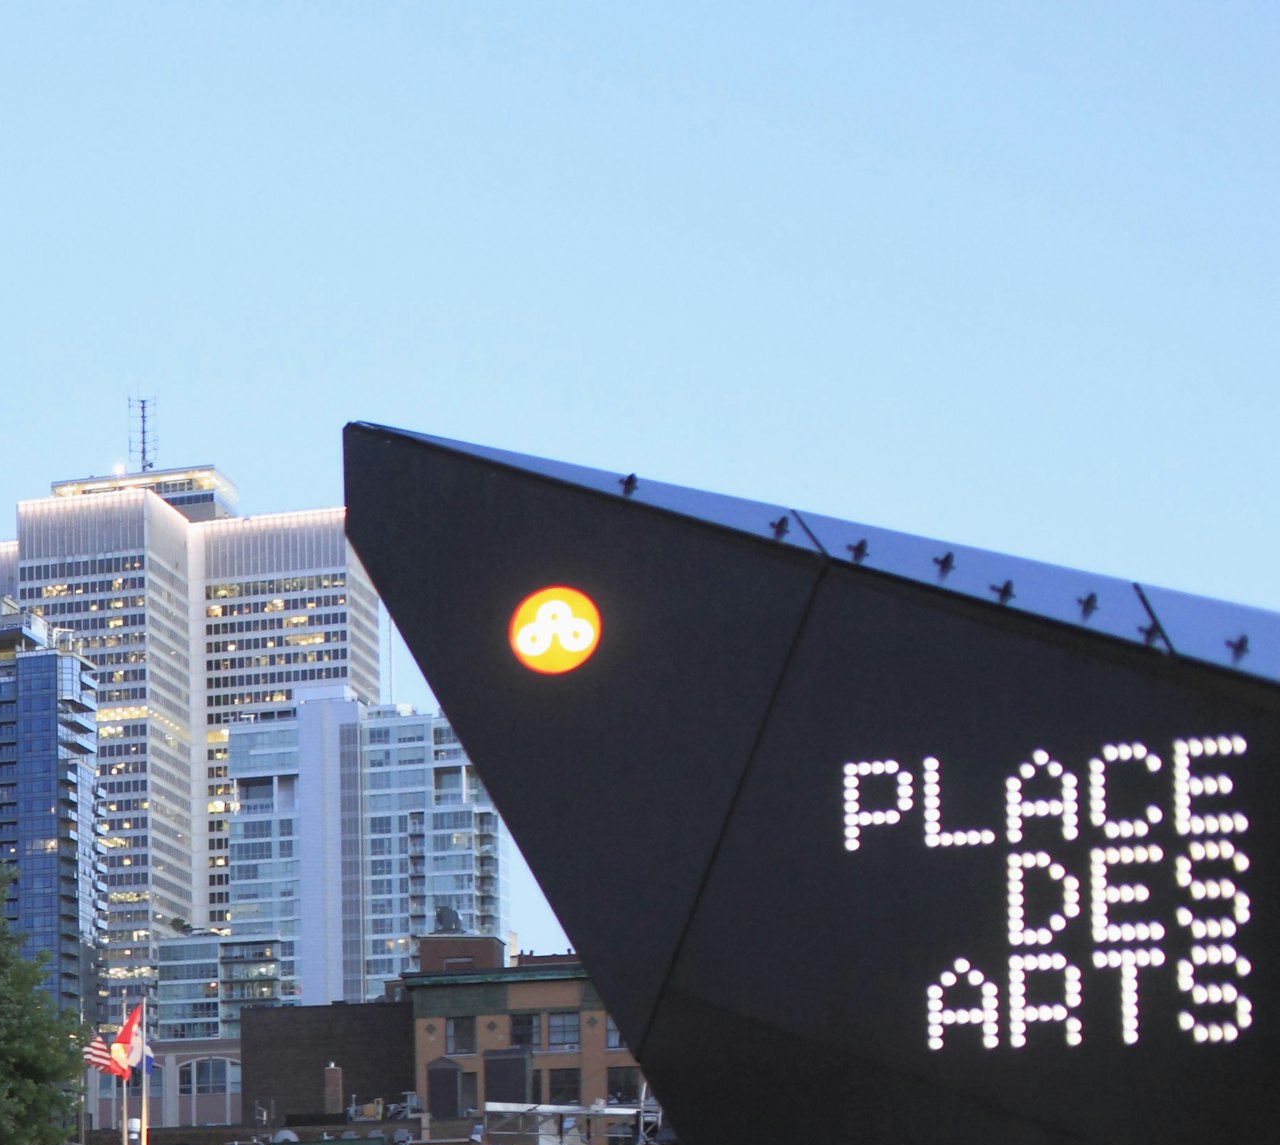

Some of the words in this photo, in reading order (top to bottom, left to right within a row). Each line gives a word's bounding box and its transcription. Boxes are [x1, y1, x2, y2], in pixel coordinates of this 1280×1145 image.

[843, 733, 1248, 852] PLACE
[1006, 838, 1251, 947] DES
[927, 942, 1252, 1051] ARTS
